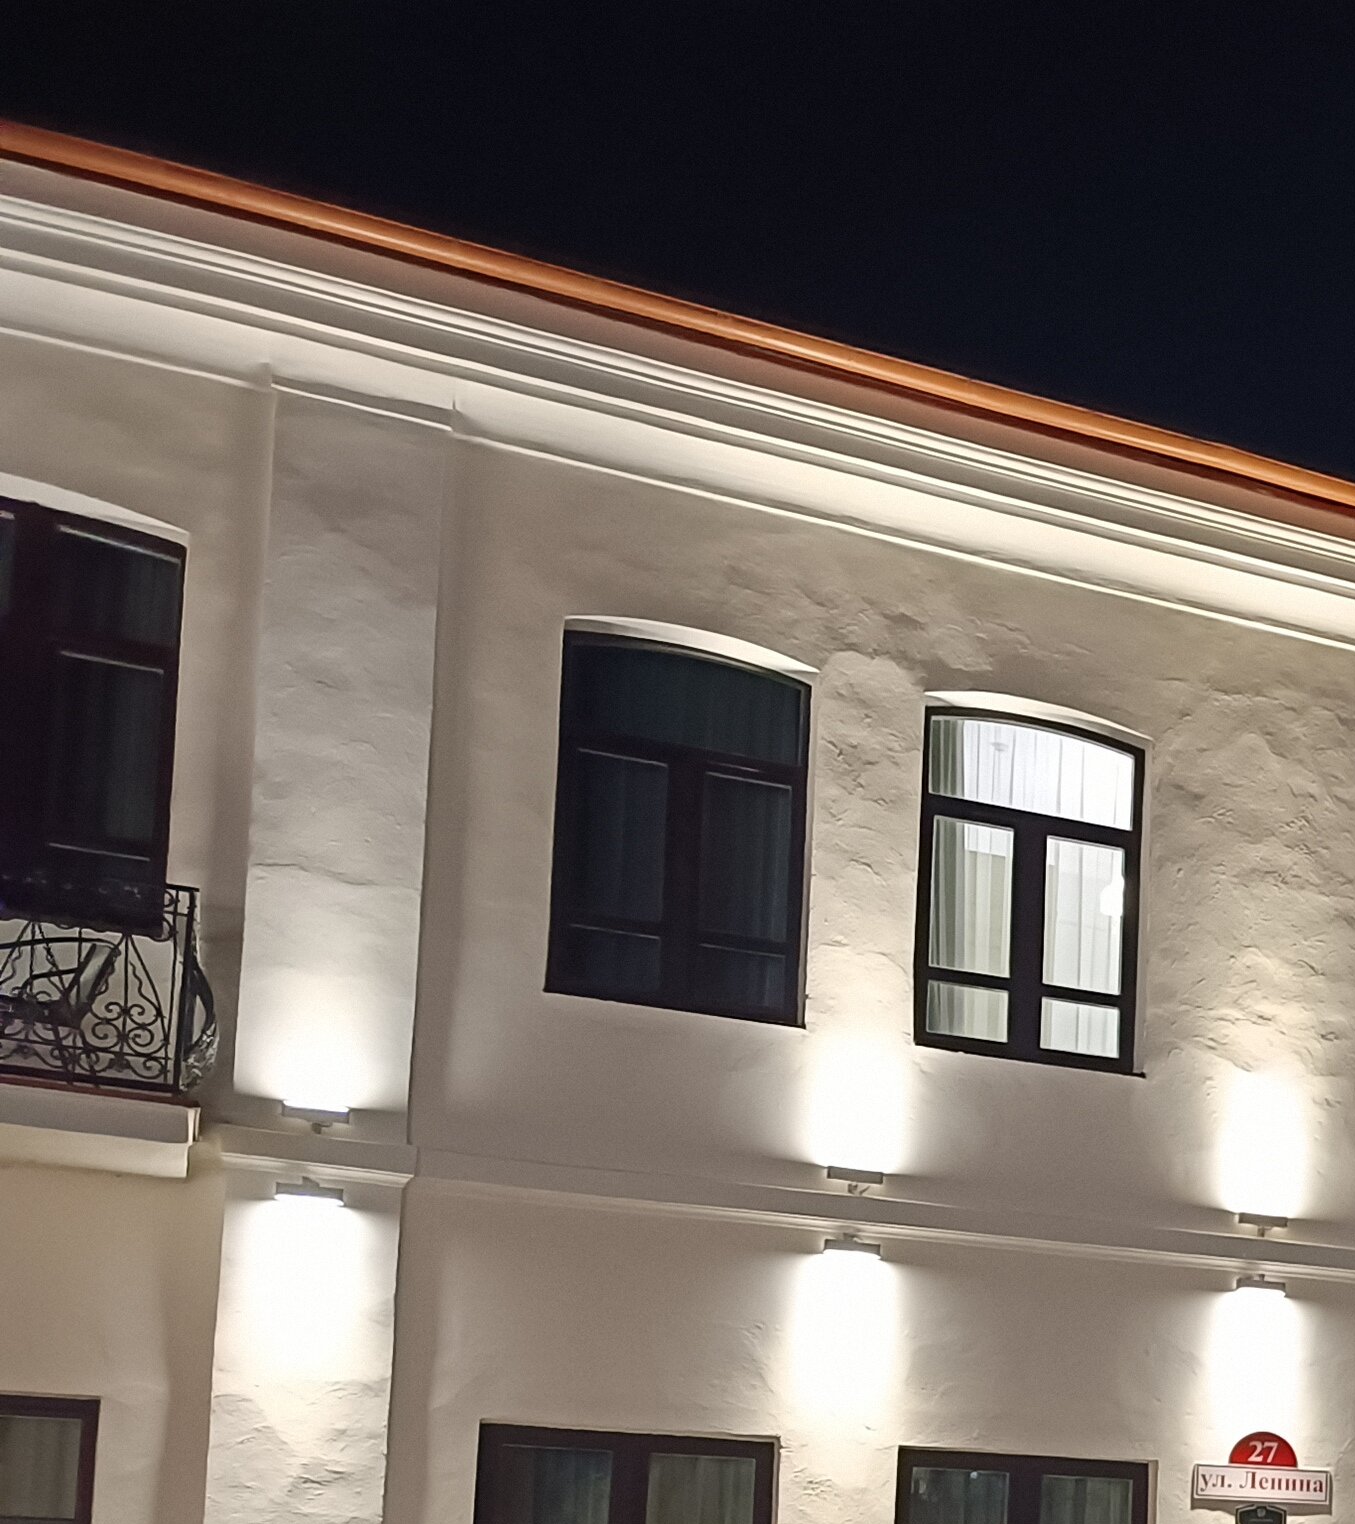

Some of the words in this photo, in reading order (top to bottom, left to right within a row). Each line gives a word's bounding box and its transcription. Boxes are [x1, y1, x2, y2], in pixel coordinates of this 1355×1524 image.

[1247, 1440, 1279, 1463] 27
[1199, 1473, 1232, 1492] ул.
[1239, 1471, 1324, 1493] Ленина
